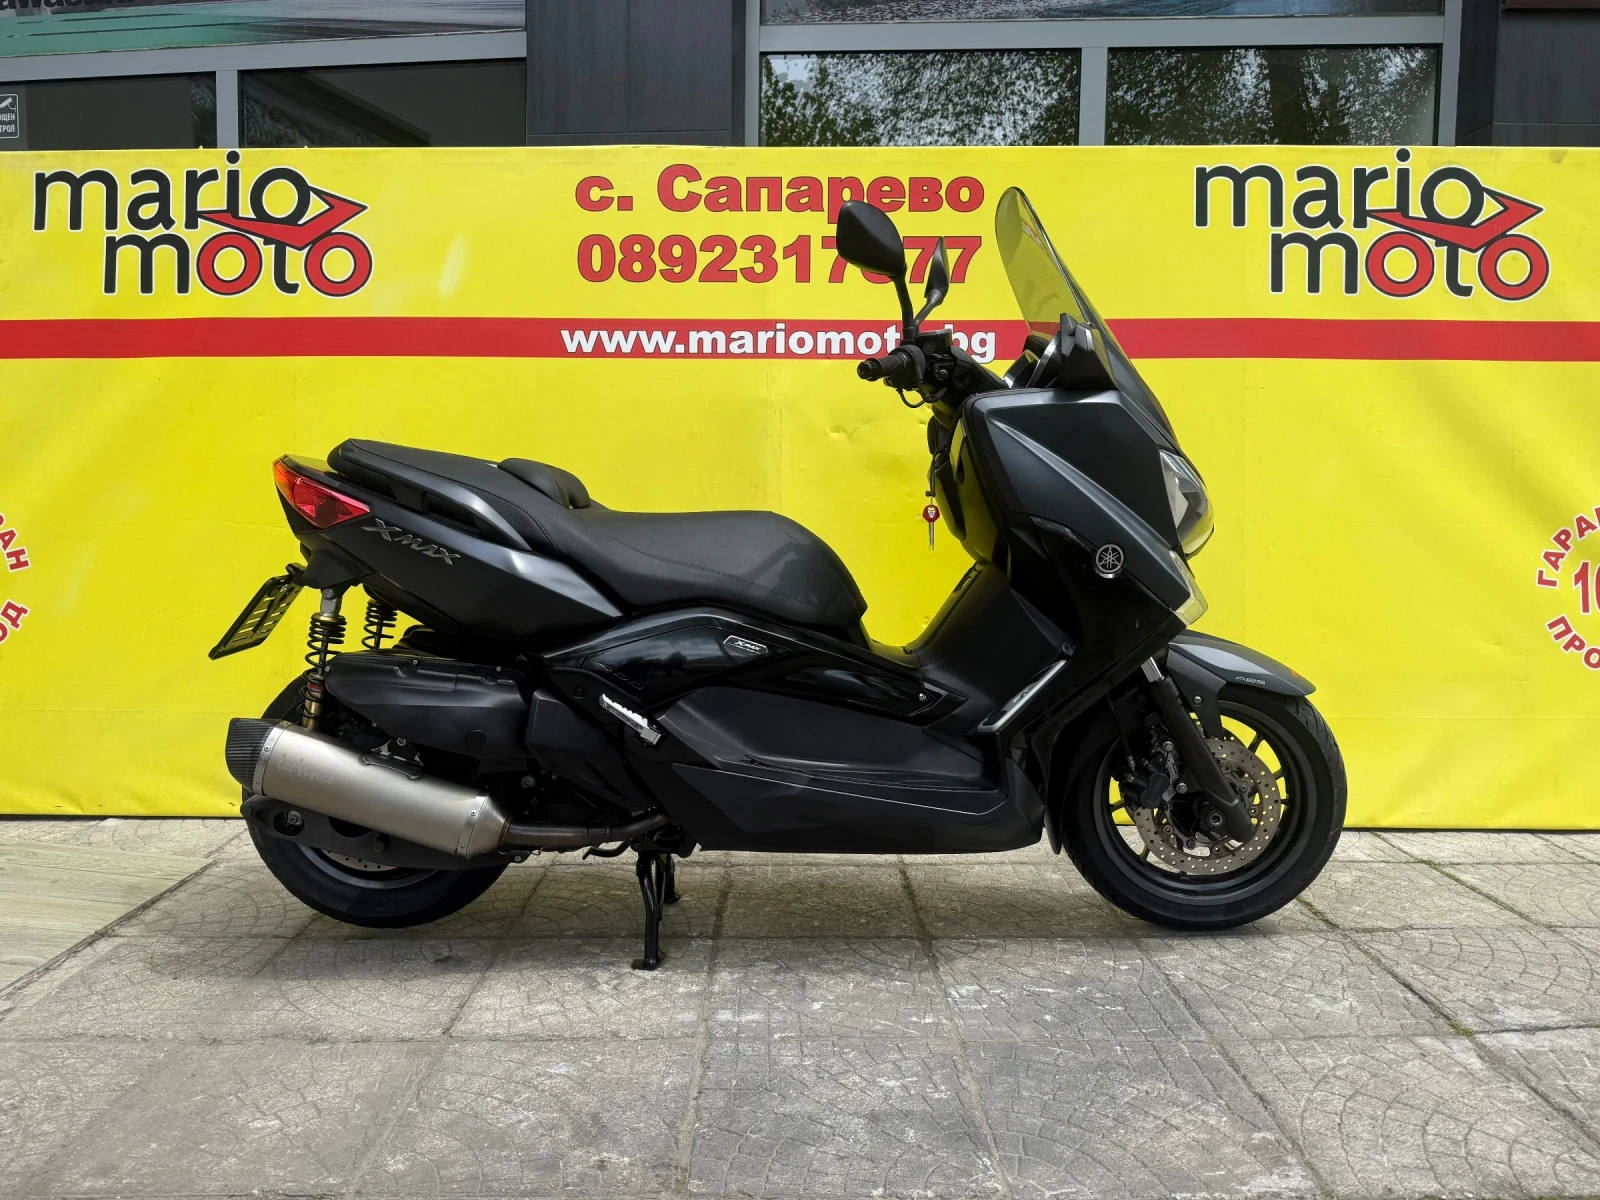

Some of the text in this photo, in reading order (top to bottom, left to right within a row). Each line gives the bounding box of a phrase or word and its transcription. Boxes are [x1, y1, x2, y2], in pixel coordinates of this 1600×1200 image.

[34, 150, 312, 231] mario
[656, 163, 986, 225] Сапарево
[1195, 147, 1485, 230] mario
[103, 232, 373, 297] moto
[577, 233, 983, 284] 089231777
[1270, 230, 1550, 301] moto
[559, 322, 998, 364] www.mariomotbg
[1573, 561, 1600, 614] 1
